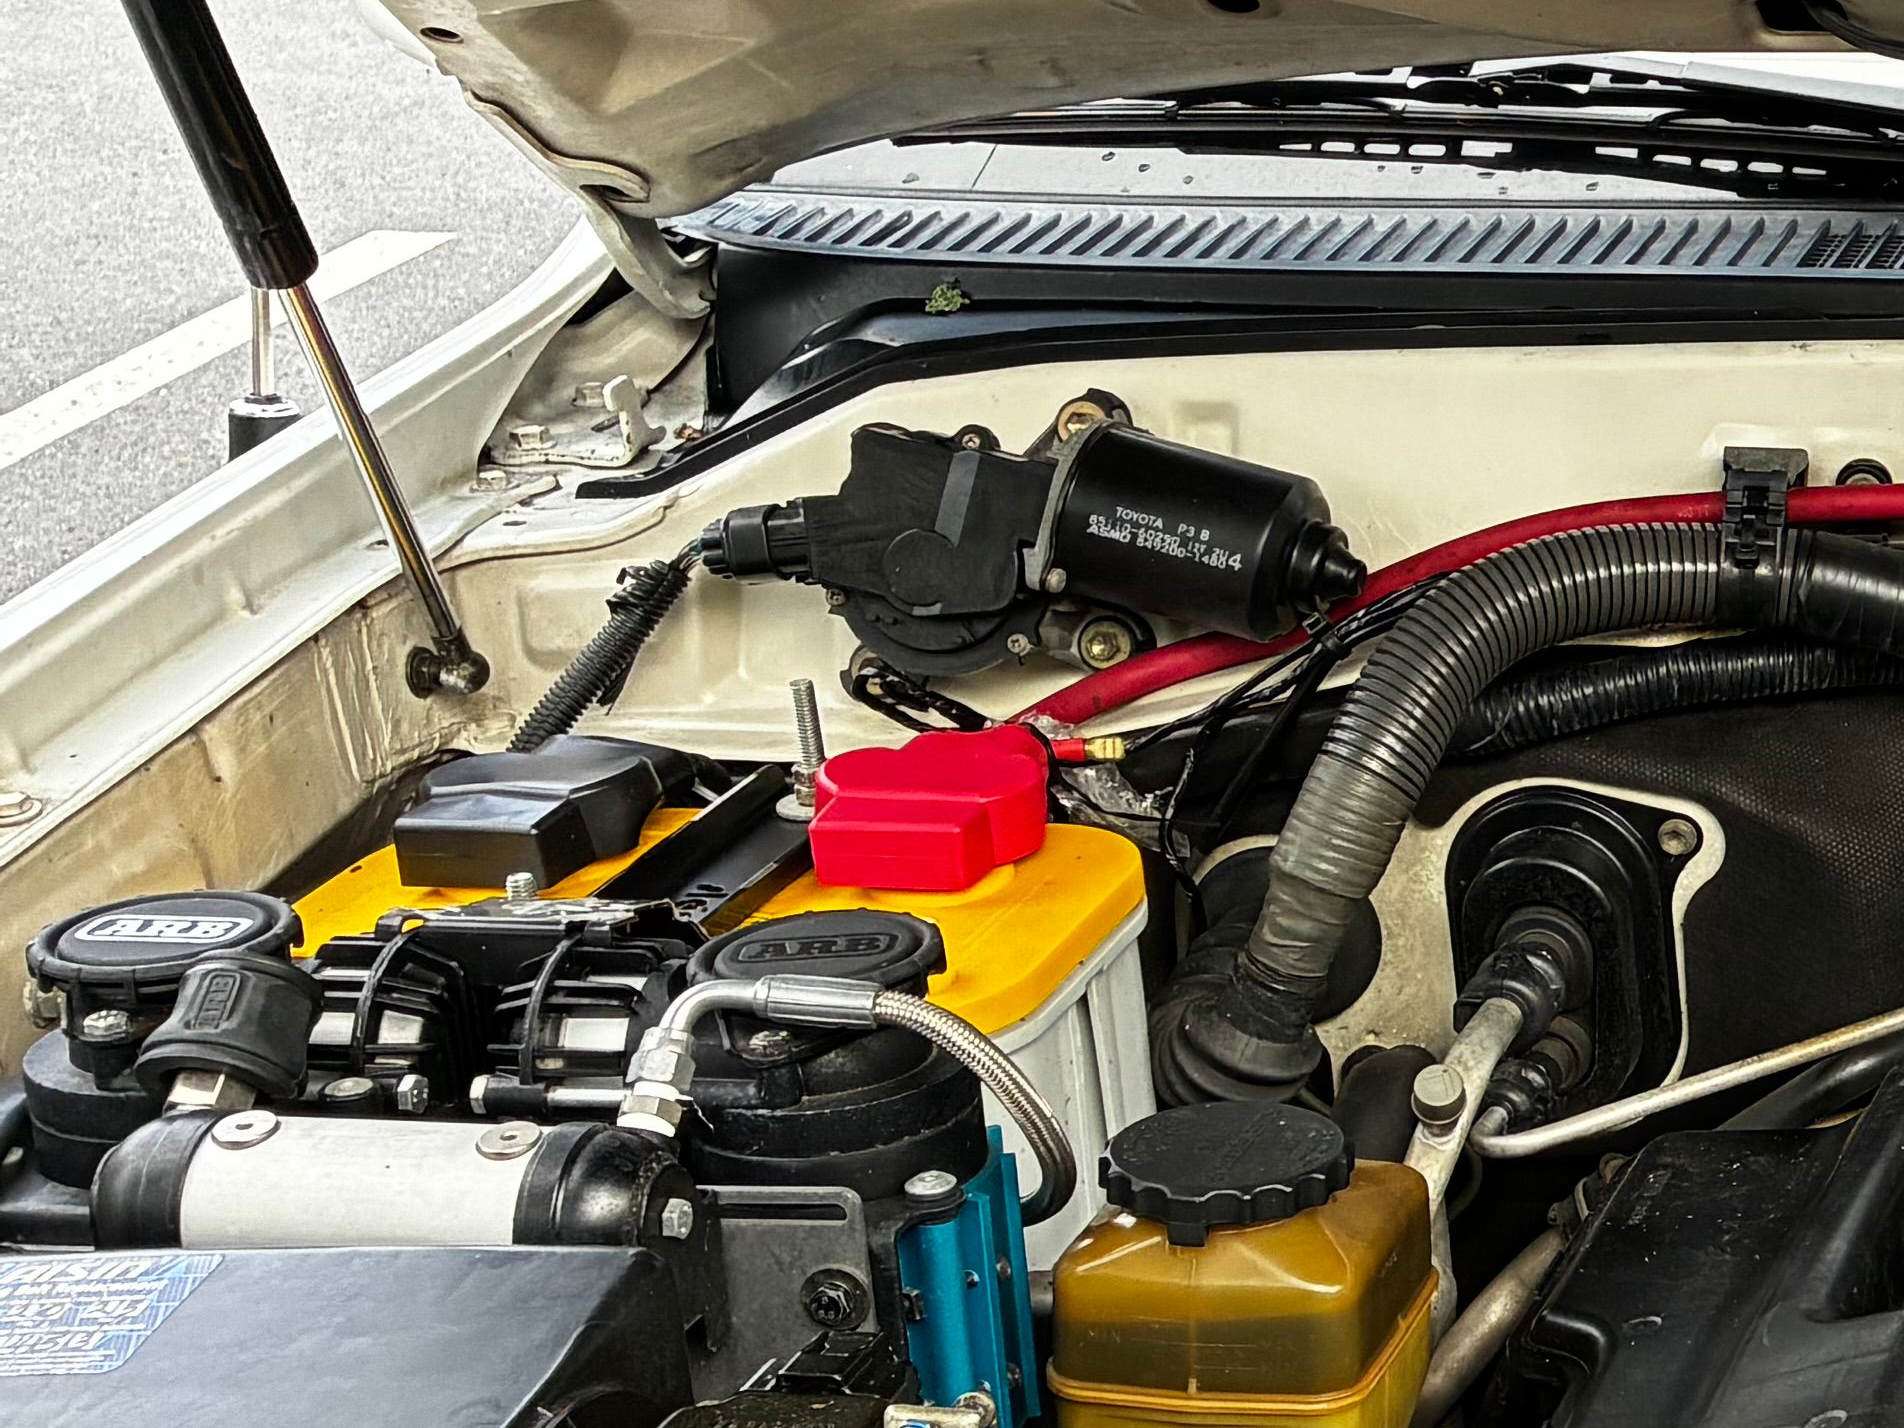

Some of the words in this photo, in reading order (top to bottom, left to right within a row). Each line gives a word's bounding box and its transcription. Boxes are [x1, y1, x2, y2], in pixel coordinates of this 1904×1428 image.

[1115, 505, 1164, 530] TOYOTA
[1177, 523, 1195, 537] P3
[94, 919, 232, 939] ARB
[746, 936, 884, 959] ARB
[193, 977, 231, 1030] ARB
